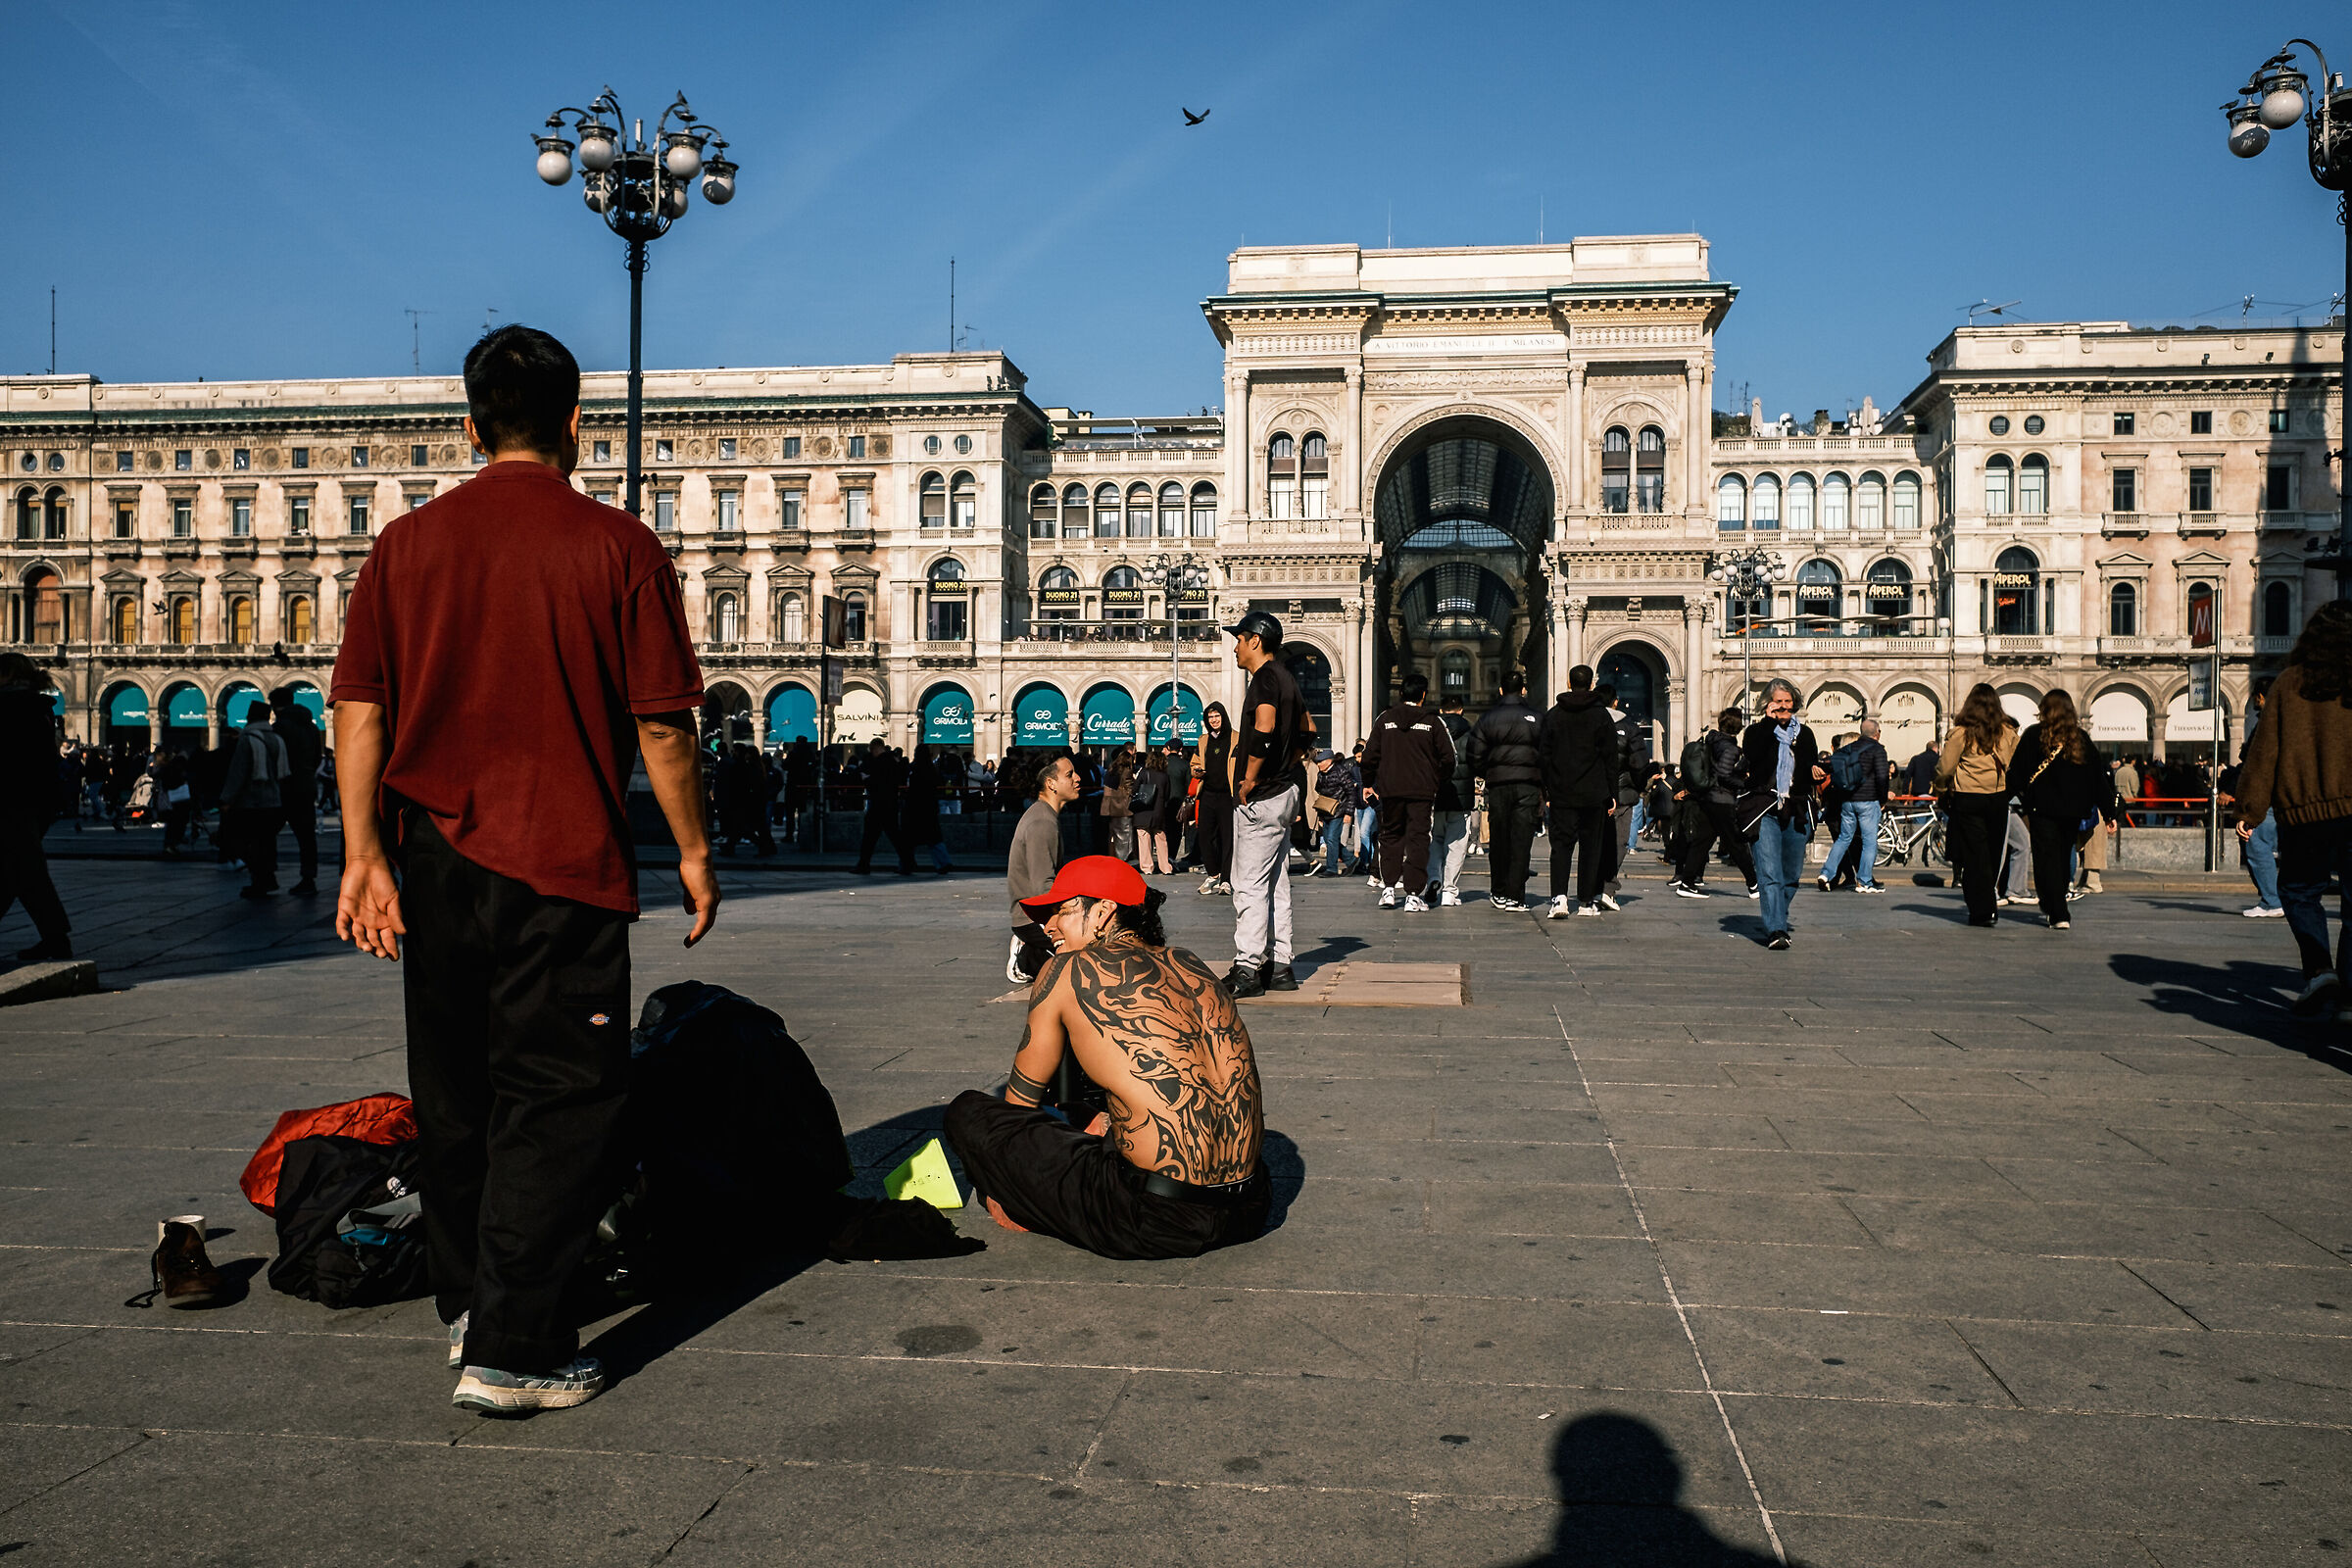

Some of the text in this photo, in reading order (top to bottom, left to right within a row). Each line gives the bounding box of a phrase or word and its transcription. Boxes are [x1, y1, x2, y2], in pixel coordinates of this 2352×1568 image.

[1994, 572, 2032, 585] APEROL
[1799, 584, 1834, 596] APEROL
[1869, 584, 1904, 596] APEROL
[2195, 605, 2211, 636] M
[1086, 712, 1130, 732] Currado
[1153, 713, 1198, 732] Curado
